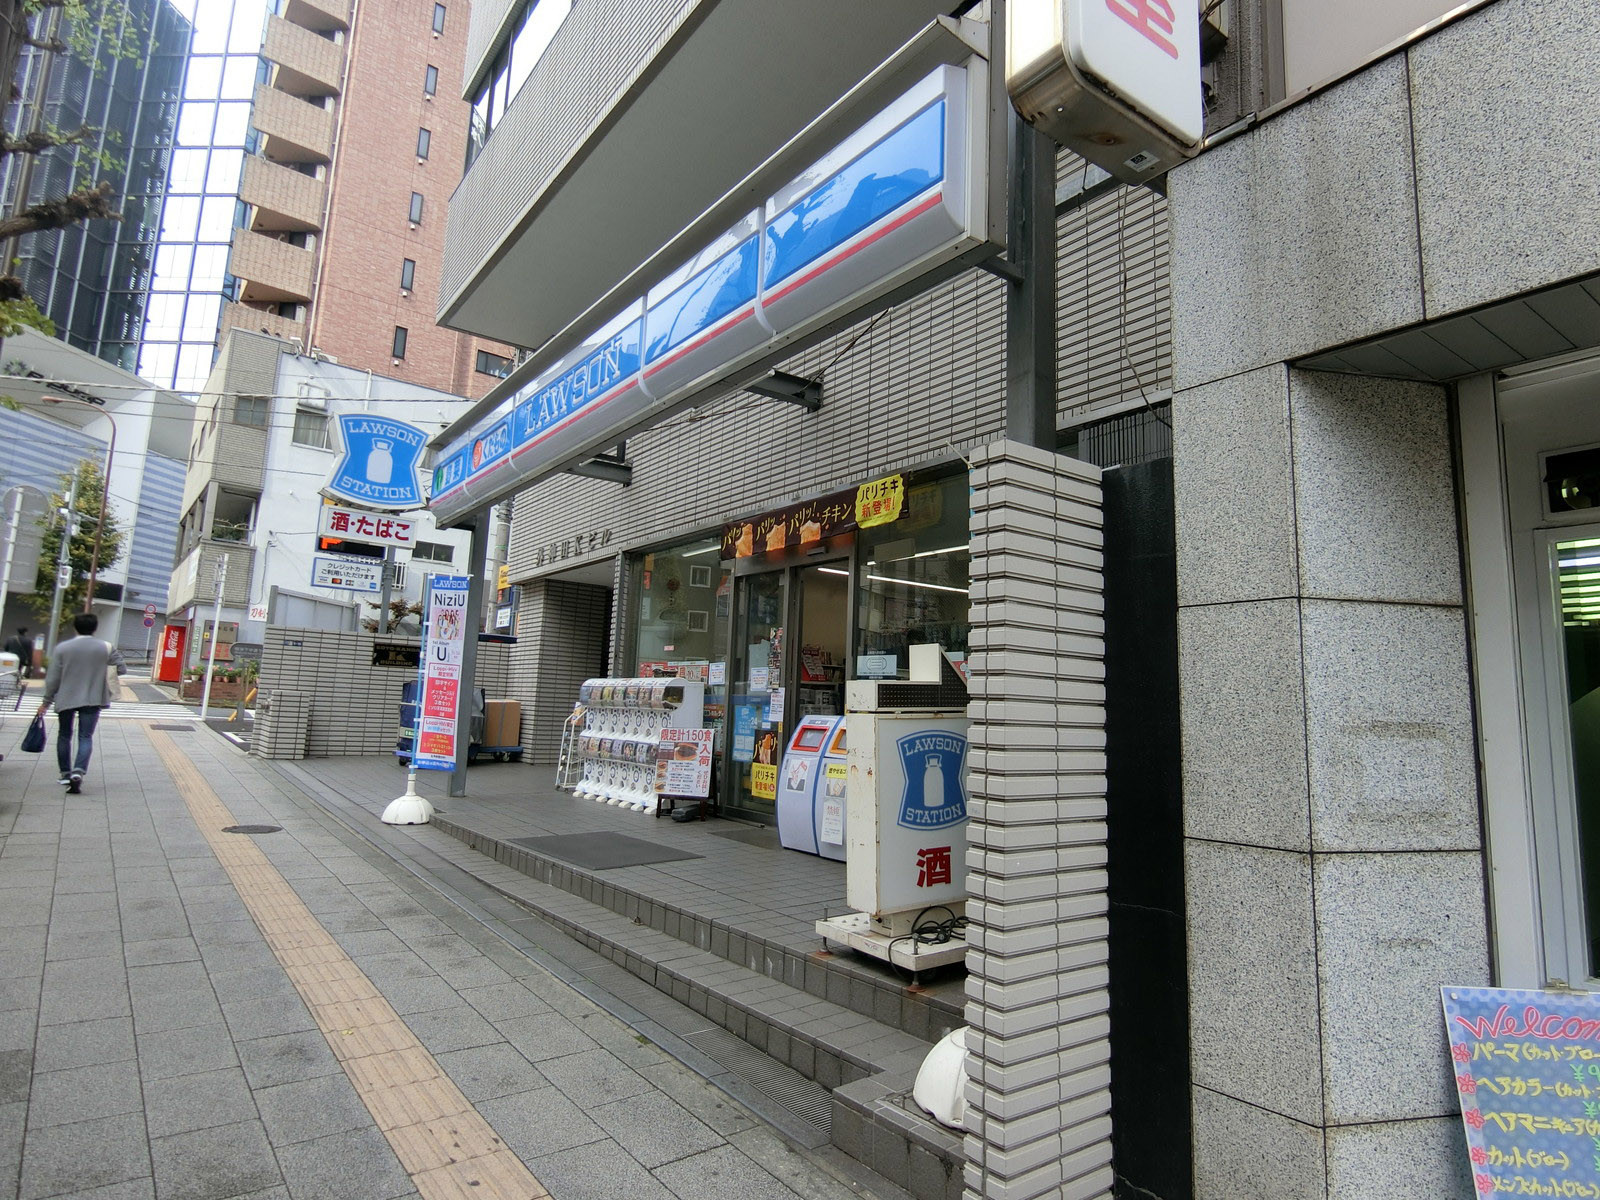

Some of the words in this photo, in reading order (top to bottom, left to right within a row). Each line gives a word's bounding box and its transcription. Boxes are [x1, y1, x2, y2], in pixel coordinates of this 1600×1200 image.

[524, 338, 623, 436] LAWSON
[348, 421, 420, 446] LAWSON
[341, 475, 413, 498] STATION
[861, 479, 898, 502] パリチキ
[862, 496, 895, 517] 新登場!
[331, 511, 410, 541] 酒・たばこ
[756, 517, 775, 541] パリッ
[789, 502, 816, 536] パリッ!
[822, 504, 852, 526] チキン
[321, 569, 375, 580] ご利用いただけます
[328, 563, 372, 573] クレジットカード
[434, 580, 467, 588] LAWSON
[435, 593, 465, 606] NiziU
[661, 729, 712, 742] 限定計150食
[699, 744, 711, 766] 入荷
[904, 737, 962, 756] LAWSON
[755, 771, 775, 781] パリチキ
[906, 803, 962, 823] STATION
[916, 846, 951, 888] 酒
